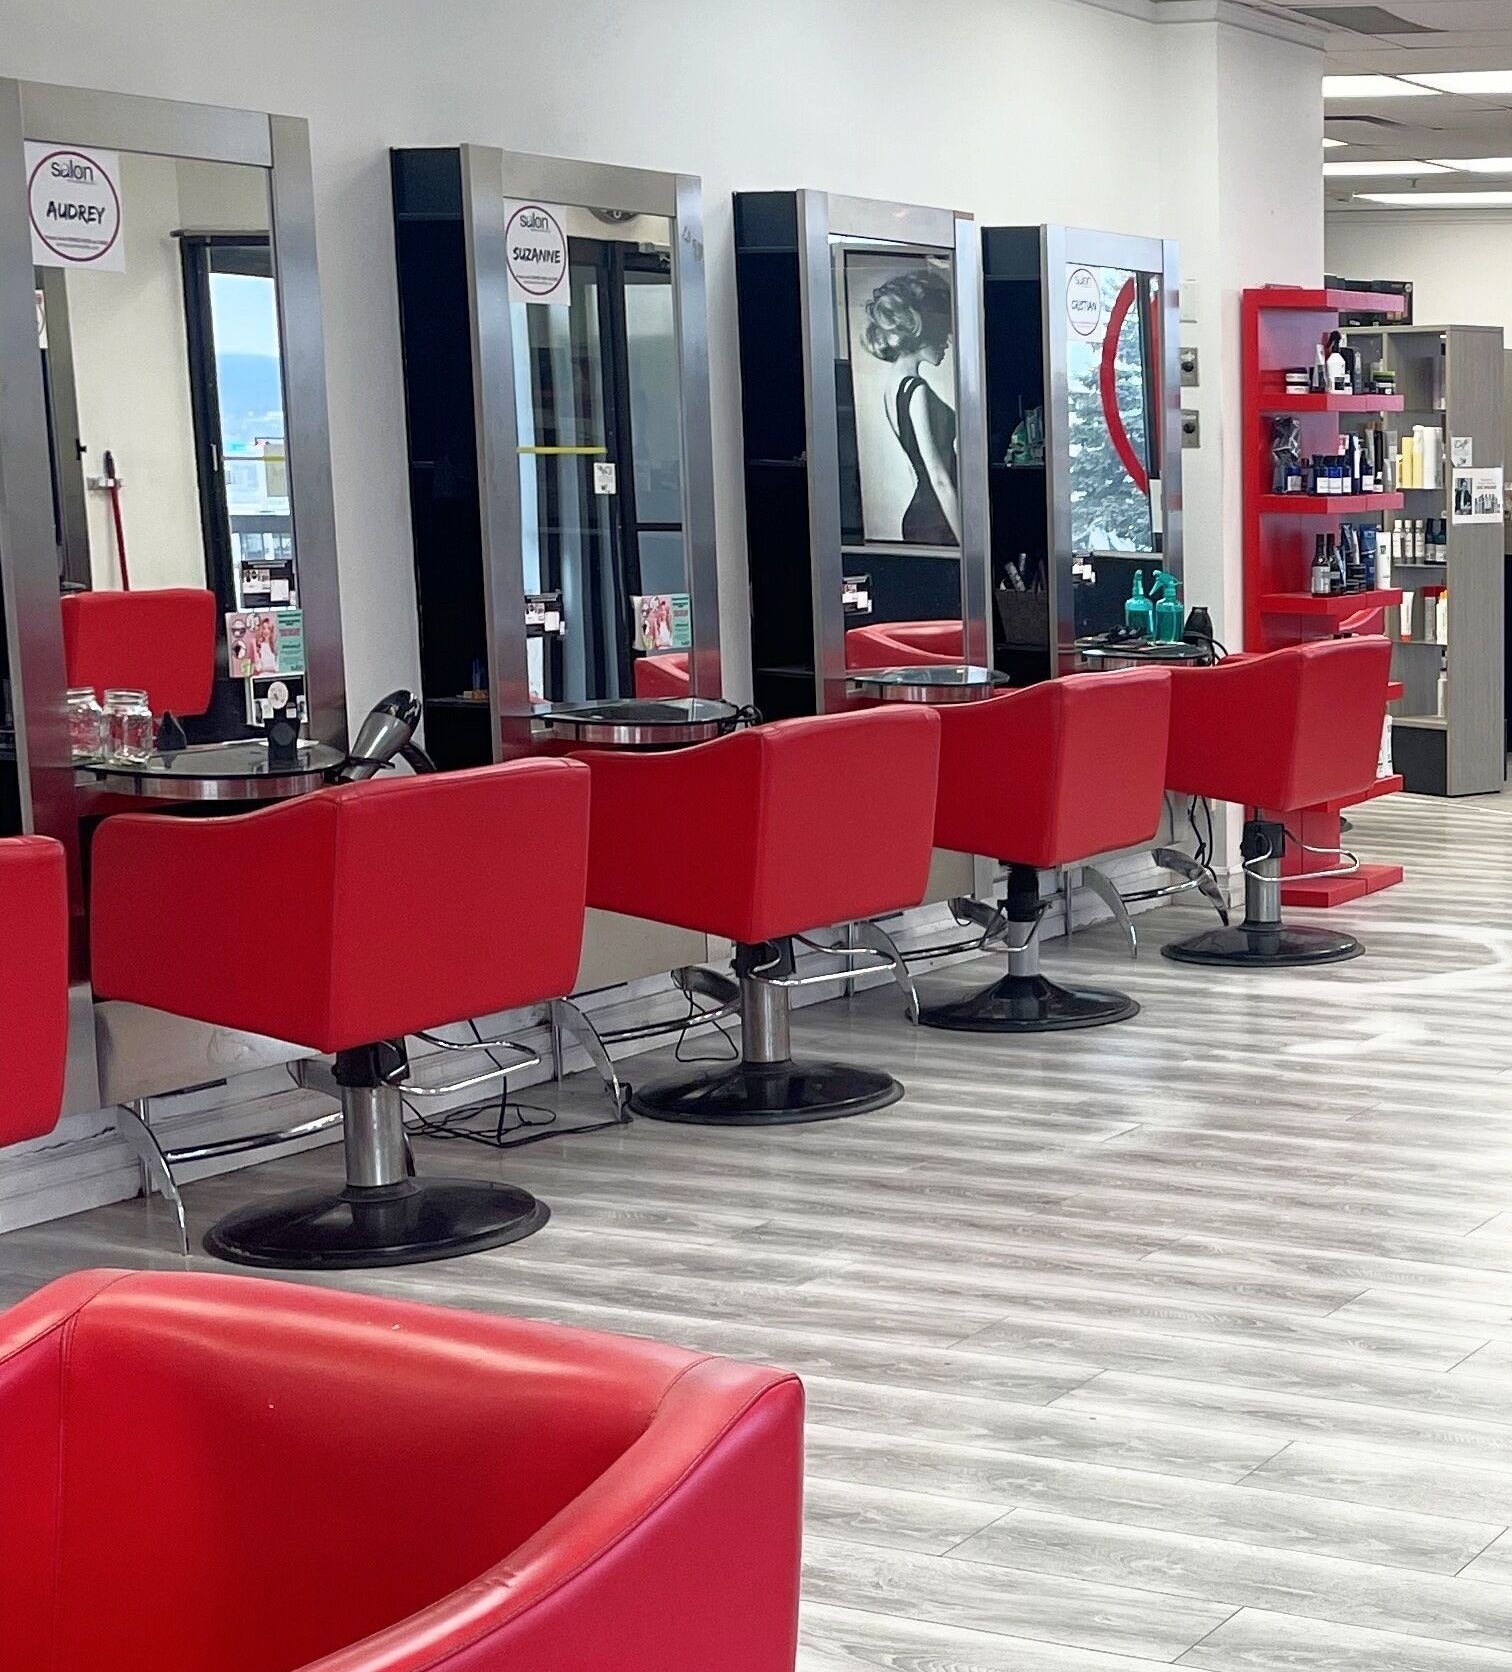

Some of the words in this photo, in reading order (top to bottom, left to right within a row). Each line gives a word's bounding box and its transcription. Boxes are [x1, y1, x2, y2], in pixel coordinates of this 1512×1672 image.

[51, 160, 93, 180] salon
[46, 201, 105, 224] AUDREY
[520, 212, 548, 230] salon
[513, 247, 561, 264] SUZANNE
